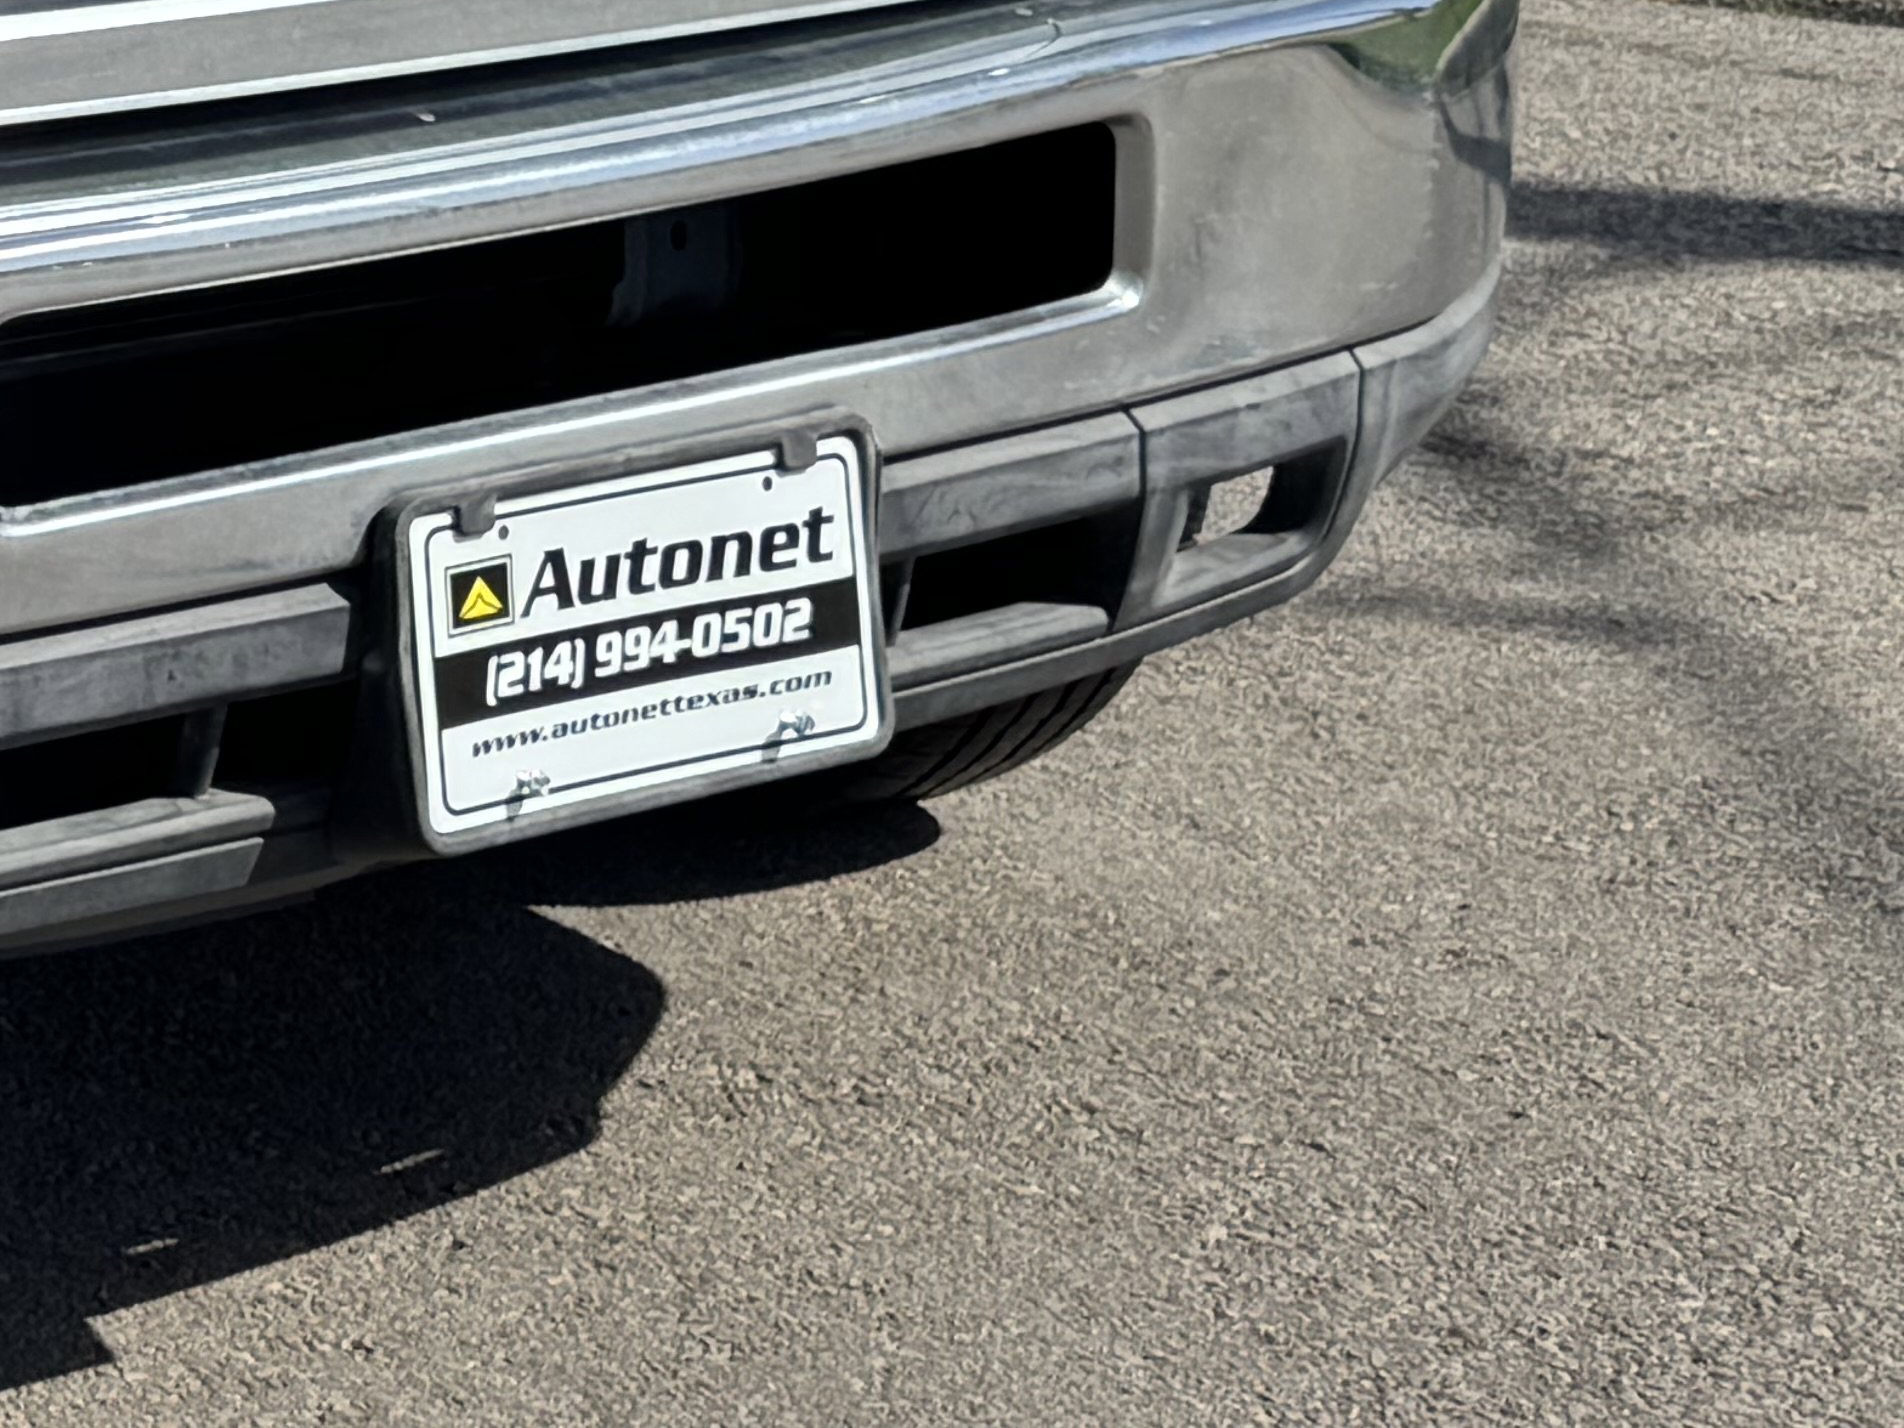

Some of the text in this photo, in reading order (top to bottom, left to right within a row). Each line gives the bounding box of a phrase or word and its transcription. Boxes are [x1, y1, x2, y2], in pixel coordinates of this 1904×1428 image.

[520, 505, 835, 618] Autonet
[486, 597, 813, 706] (214) 994-0502
[471, 669, 833, 758] www.autonettexas.com
